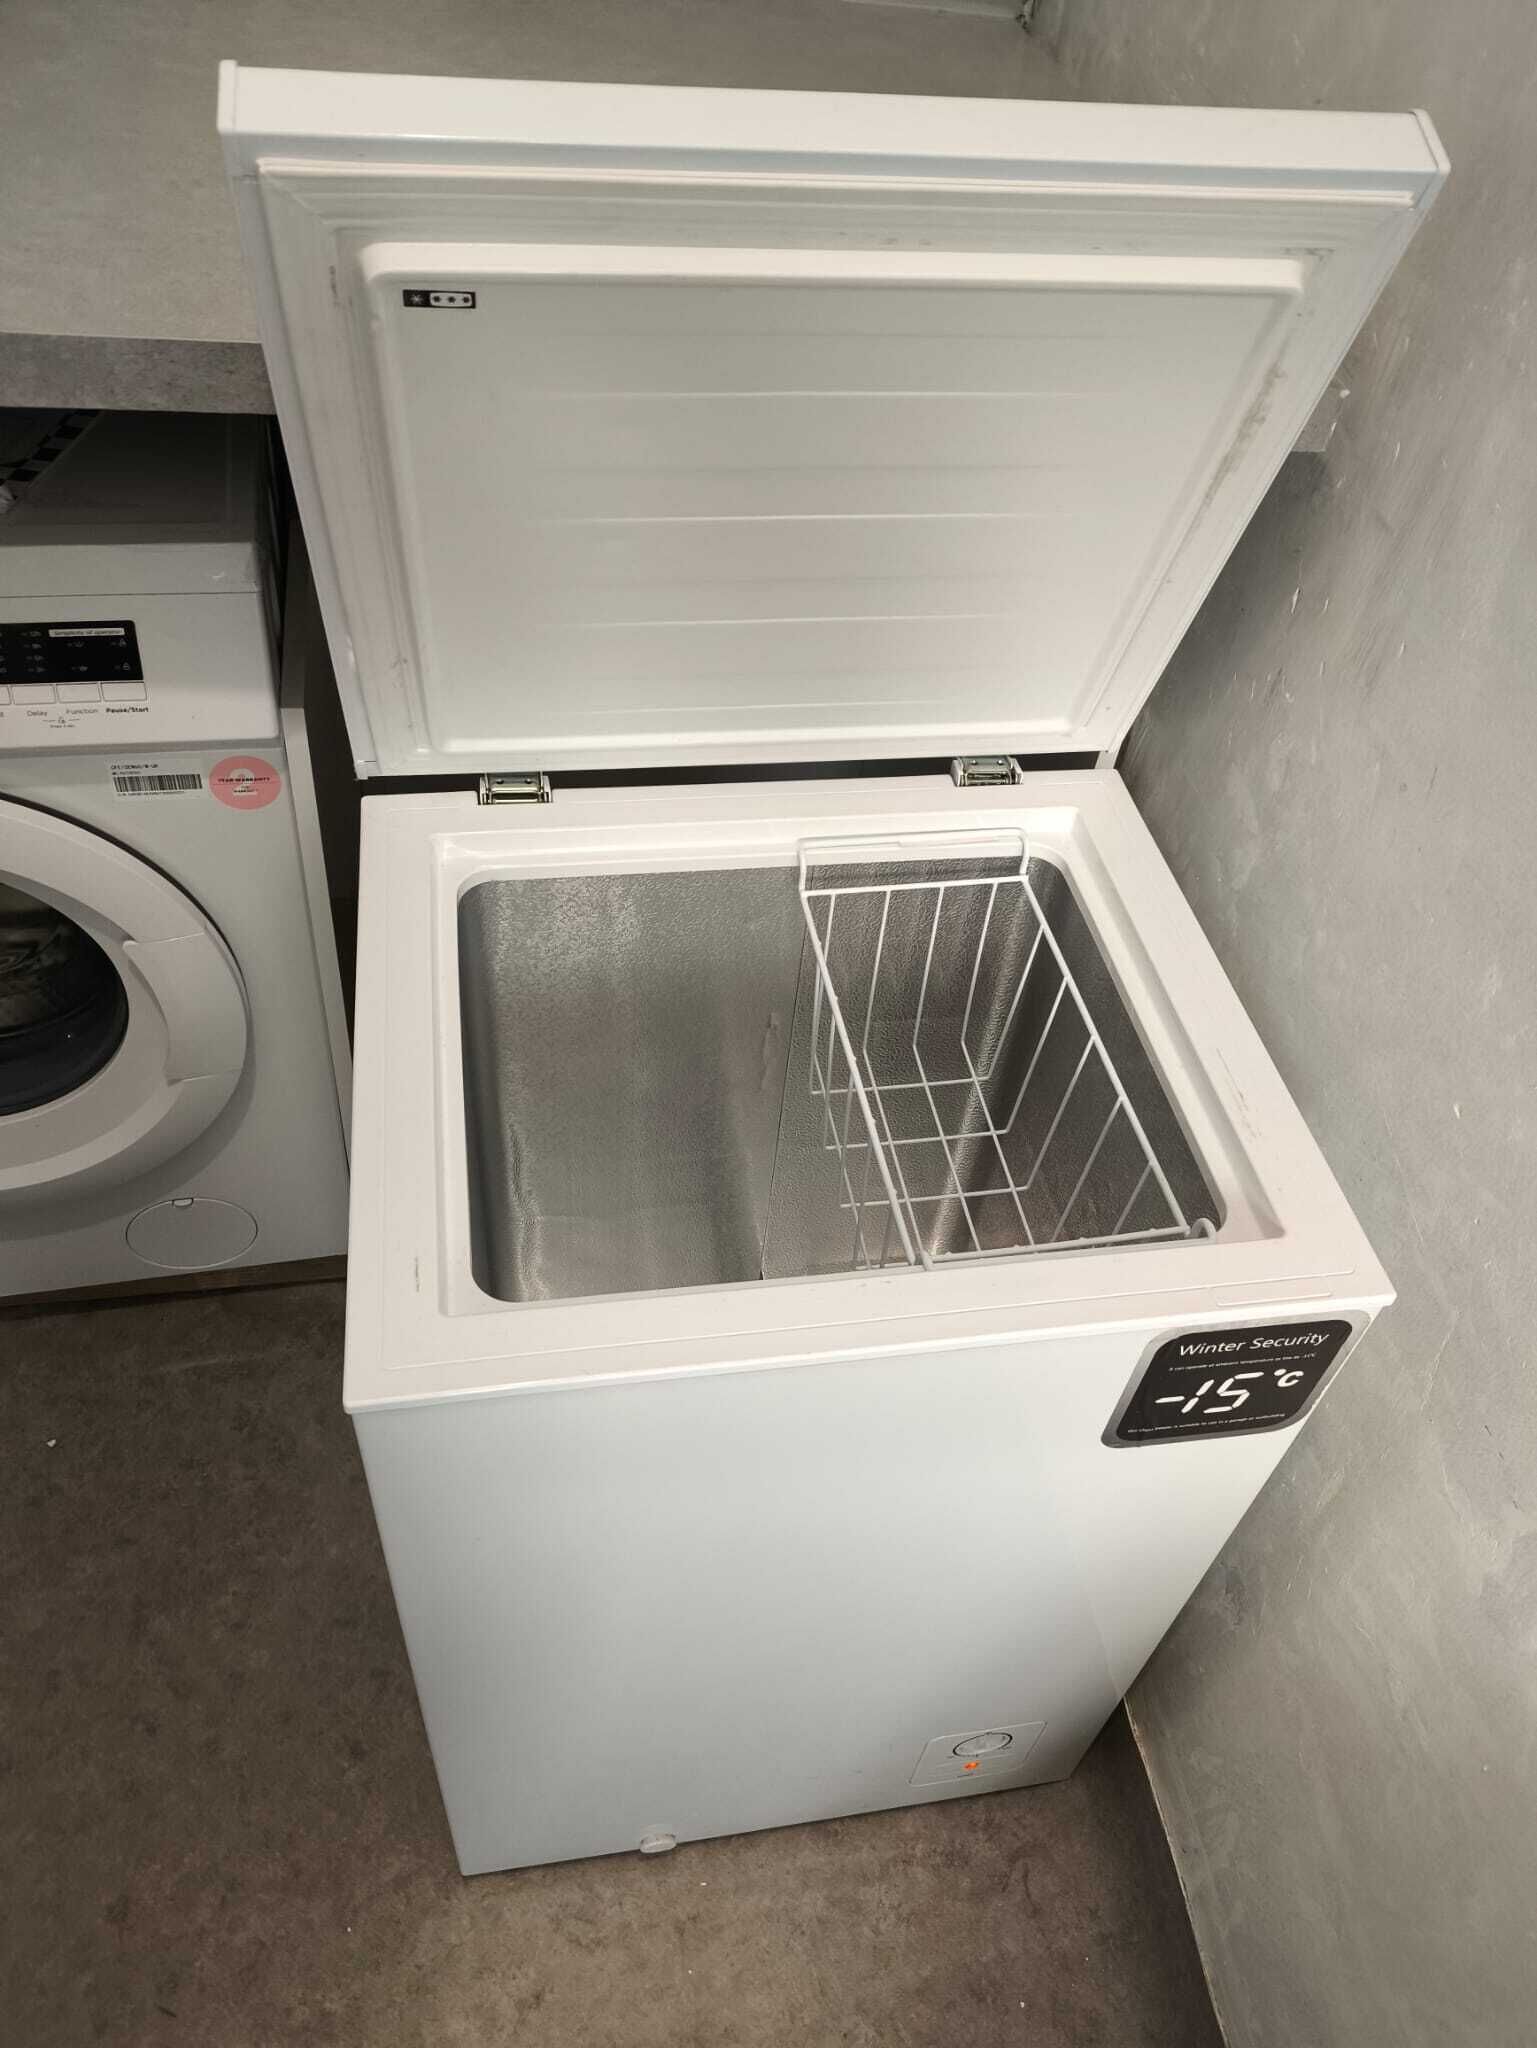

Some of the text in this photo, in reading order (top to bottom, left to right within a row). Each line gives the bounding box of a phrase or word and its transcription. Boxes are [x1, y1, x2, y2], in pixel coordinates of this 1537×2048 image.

[105, 706, 149, 714] Pause/Start
[1179, 1331, 1331, 1357] Winter Security
